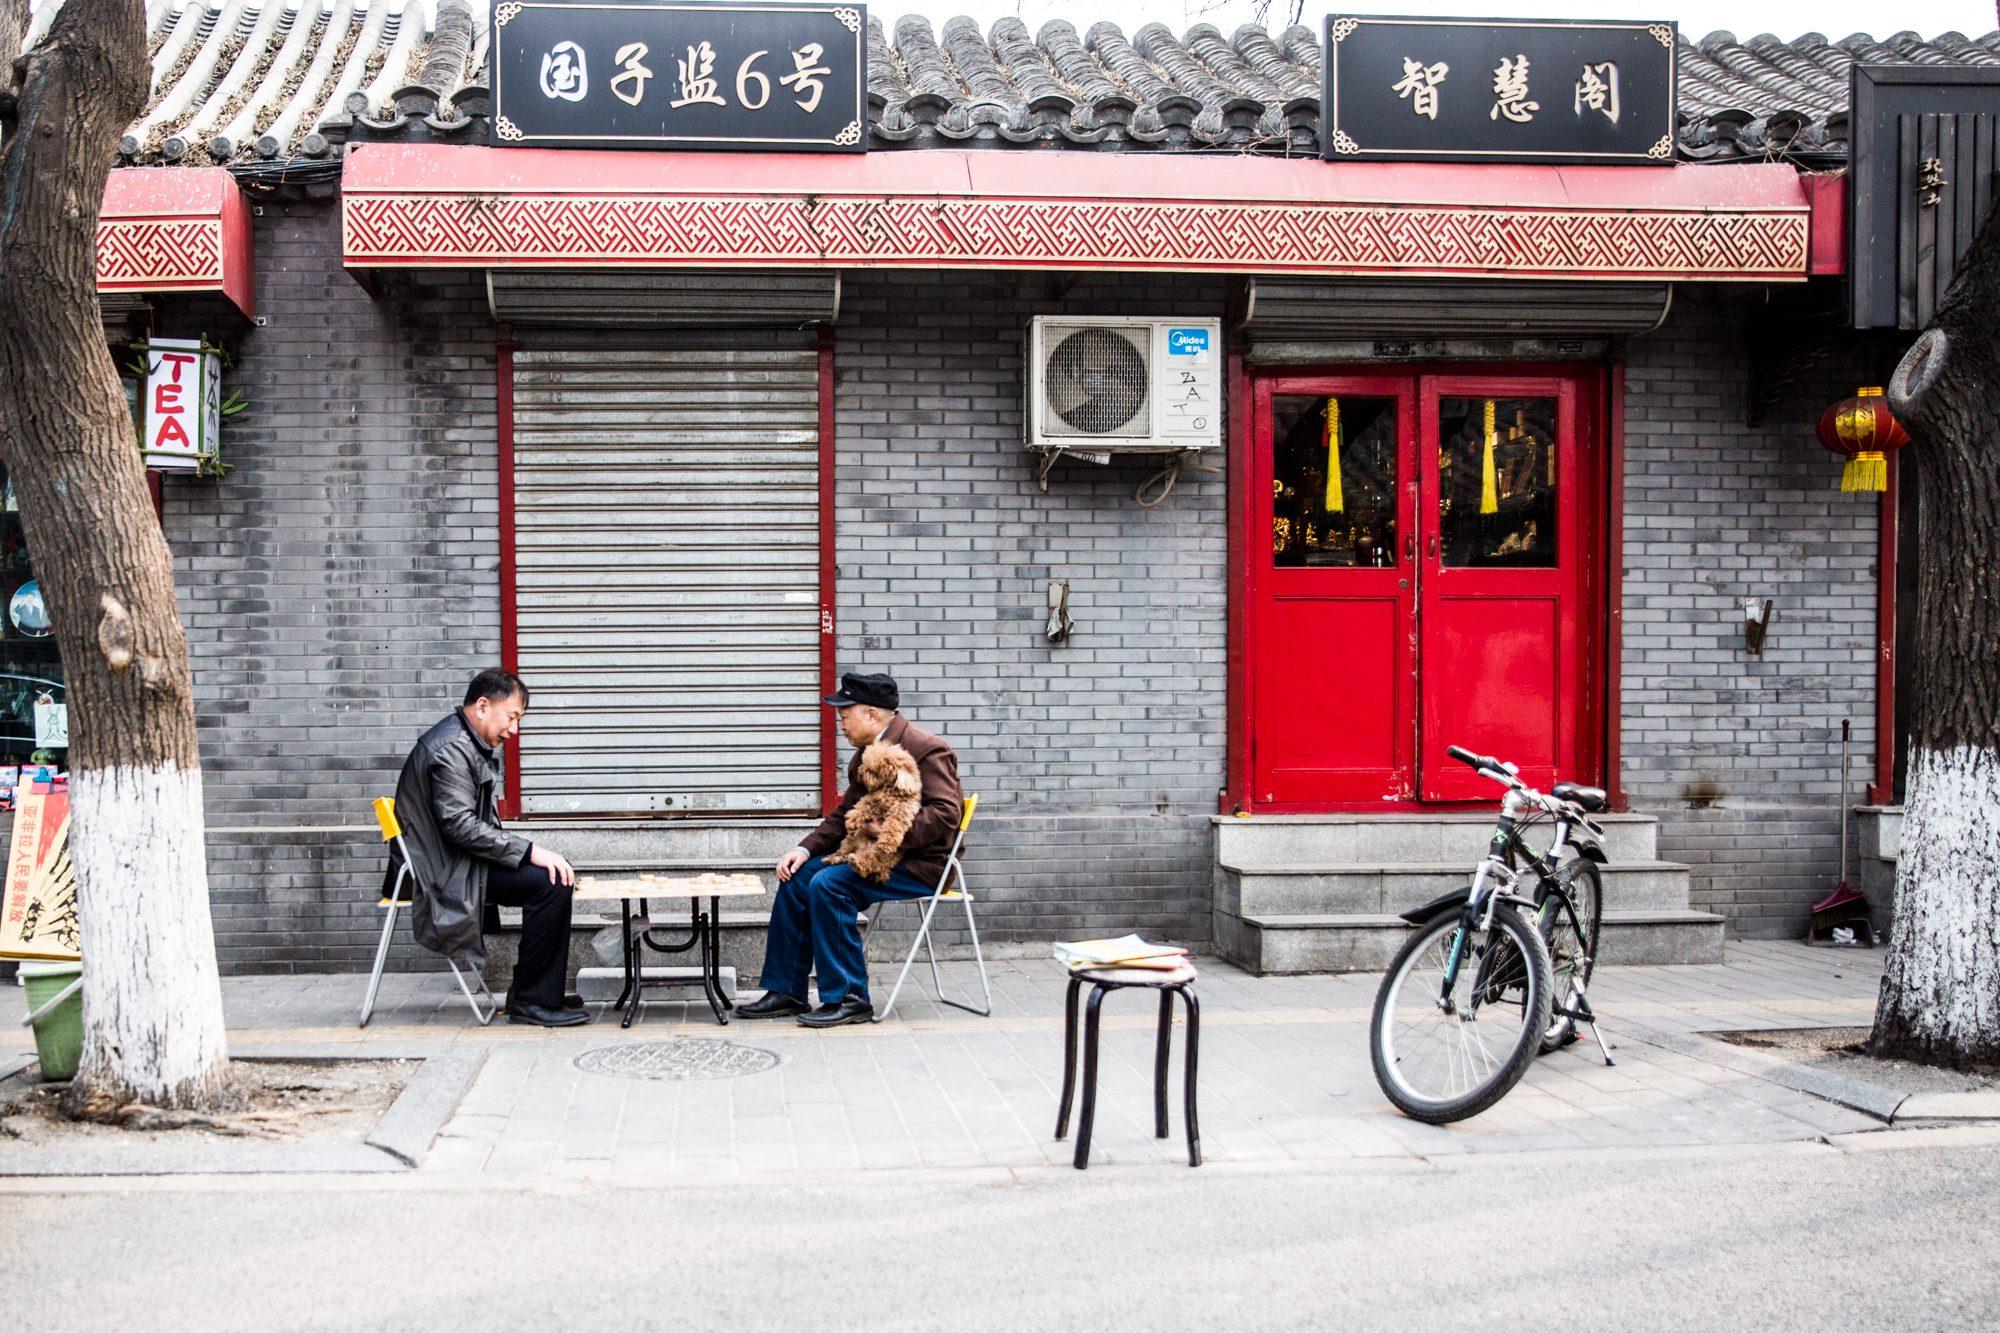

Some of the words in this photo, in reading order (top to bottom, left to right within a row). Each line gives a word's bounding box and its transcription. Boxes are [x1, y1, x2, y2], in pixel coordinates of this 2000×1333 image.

[539, 40, 832, 113] 国子监6号
[1391, 54, 1620, 125] 智慧阁
[1179, 336, 1205, 345] Midea
[155, 353, 195, 447] TEA
[8, 804, 39, 923] 亚非拉人民要解放
